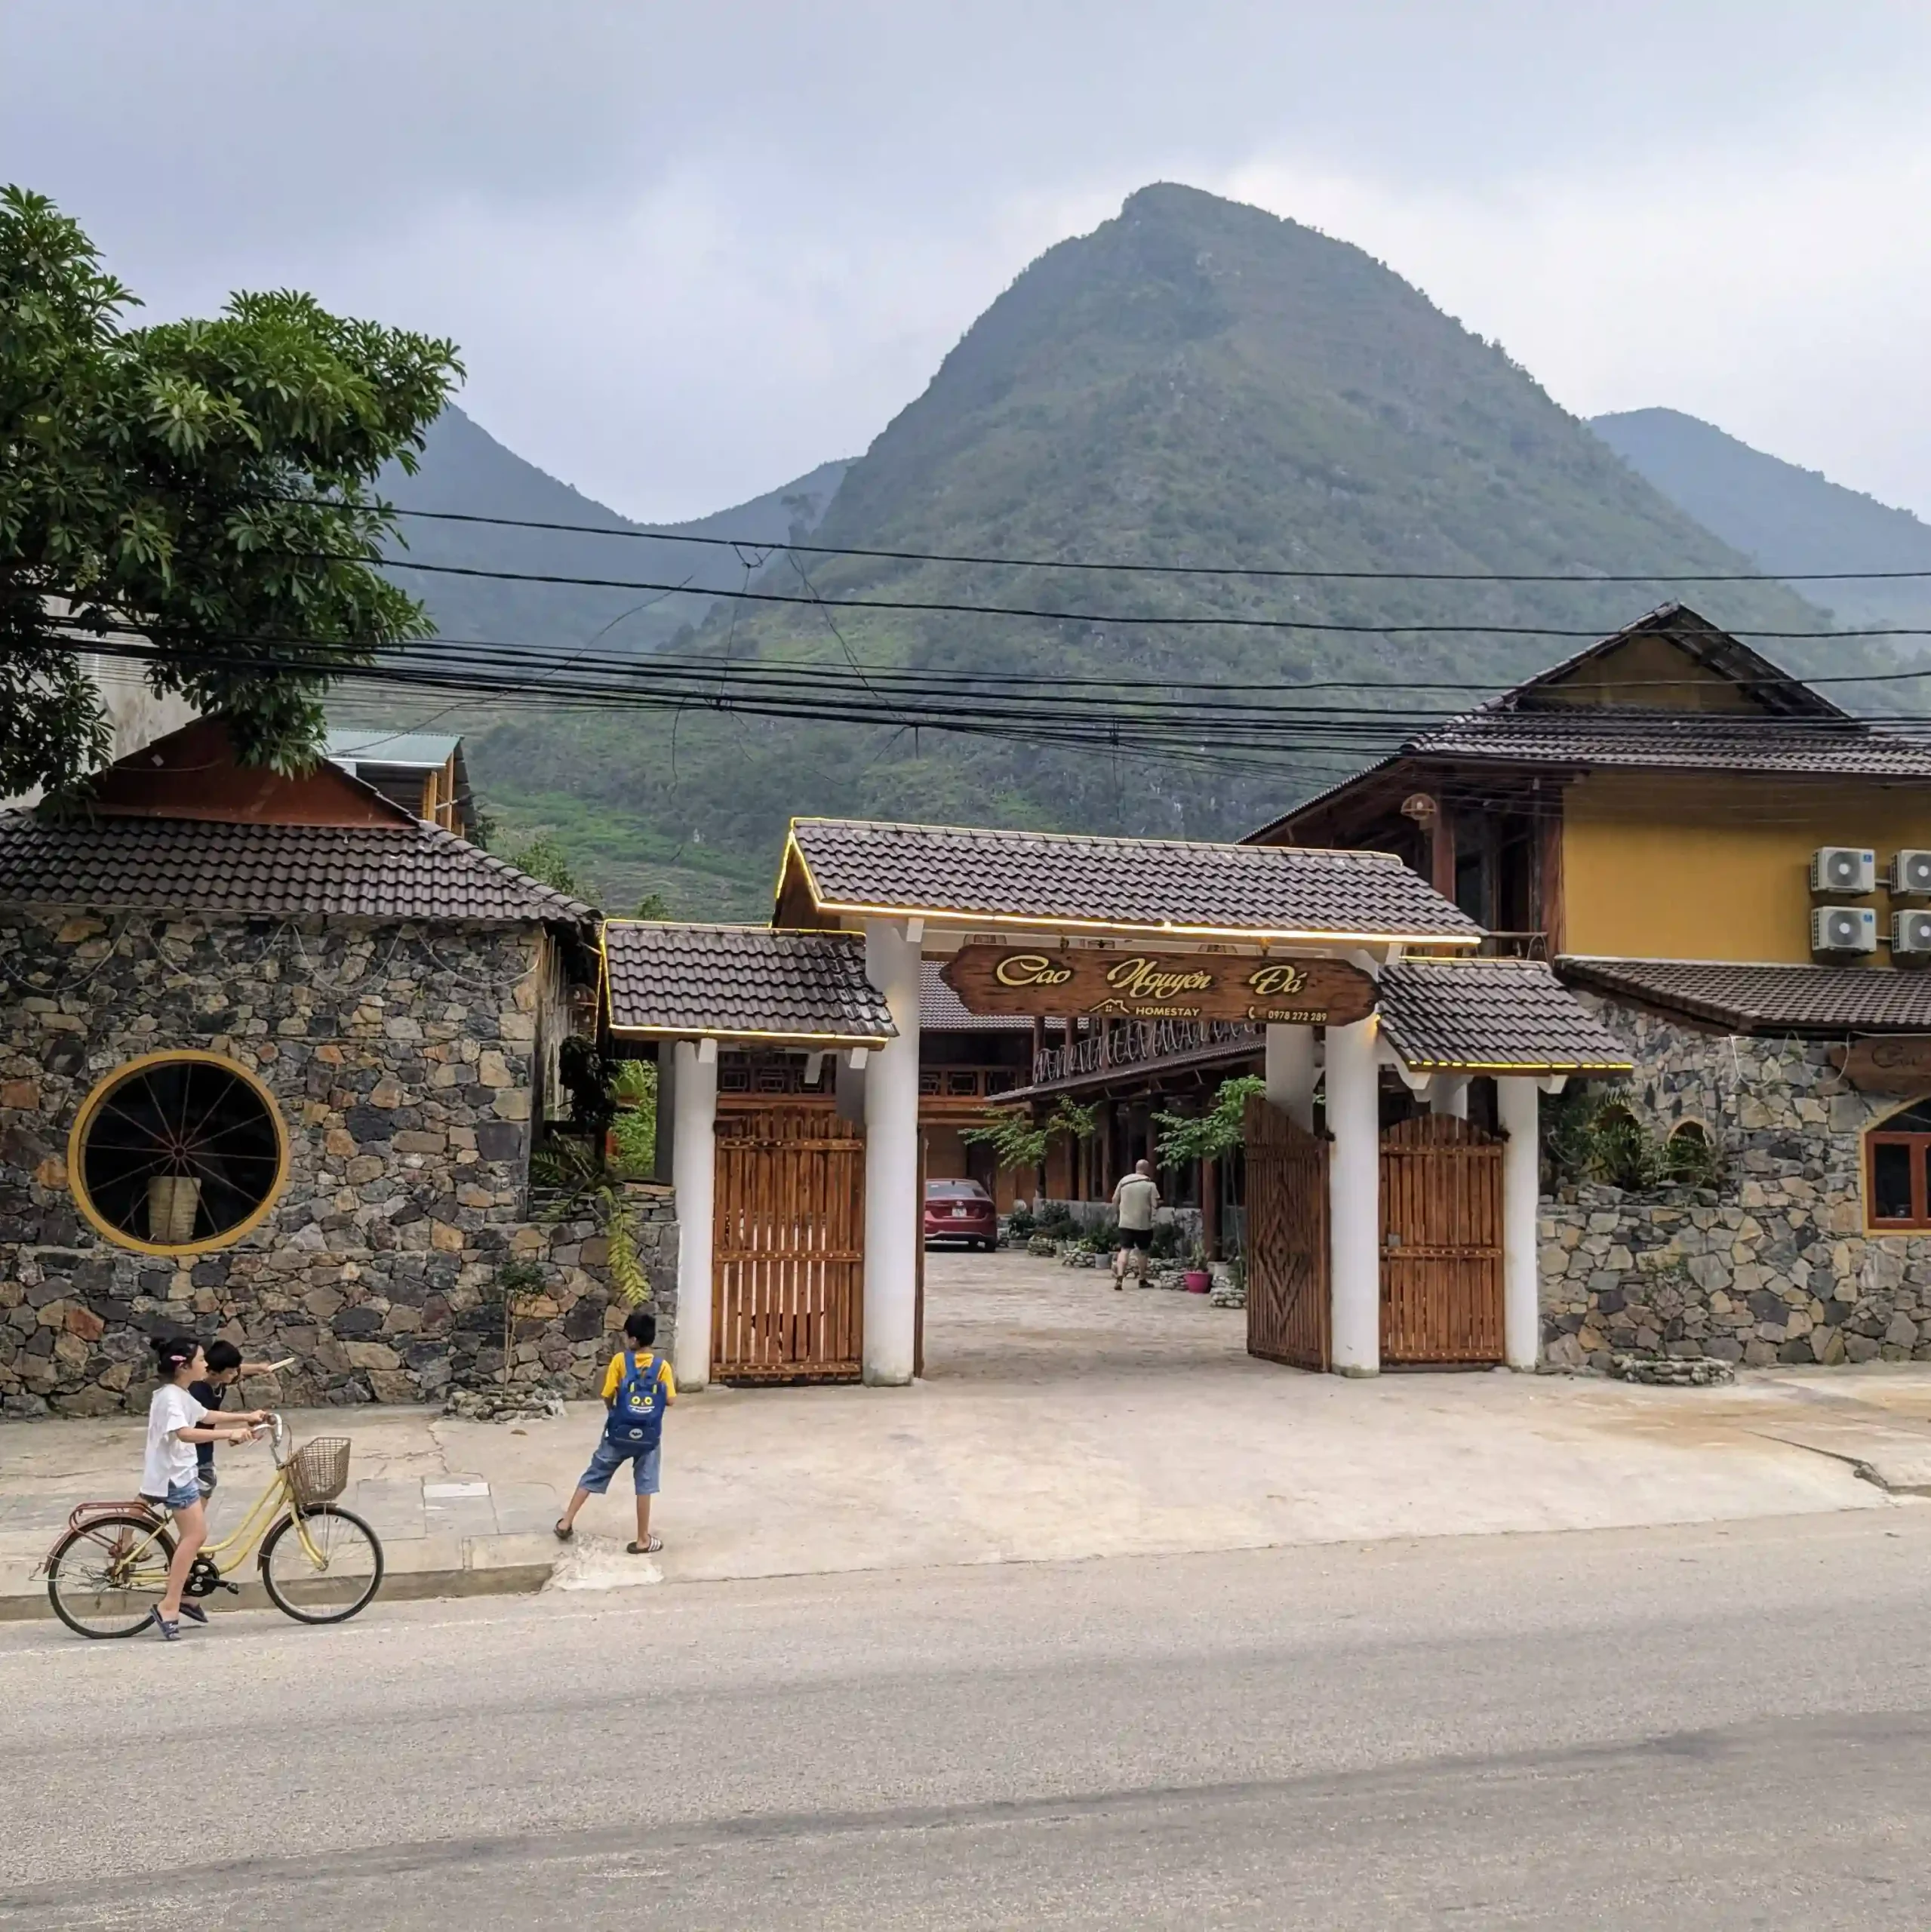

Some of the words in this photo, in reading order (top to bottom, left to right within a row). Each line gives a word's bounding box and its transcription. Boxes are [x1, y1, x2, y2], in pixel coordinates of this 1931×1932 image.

[997, 955, 1071, 986] Cao
[1107, 958, 1212, 998] Nguyên
[1249, 965, 1308, 995] Đá
[1136, 1007, 1201, 1017] HOMESTAY
[1268, 1011, 1290, 1020] 0978
[1292, 1012, 1308, 1021] 272
[1311, 1013, 1327, 1021] 289
